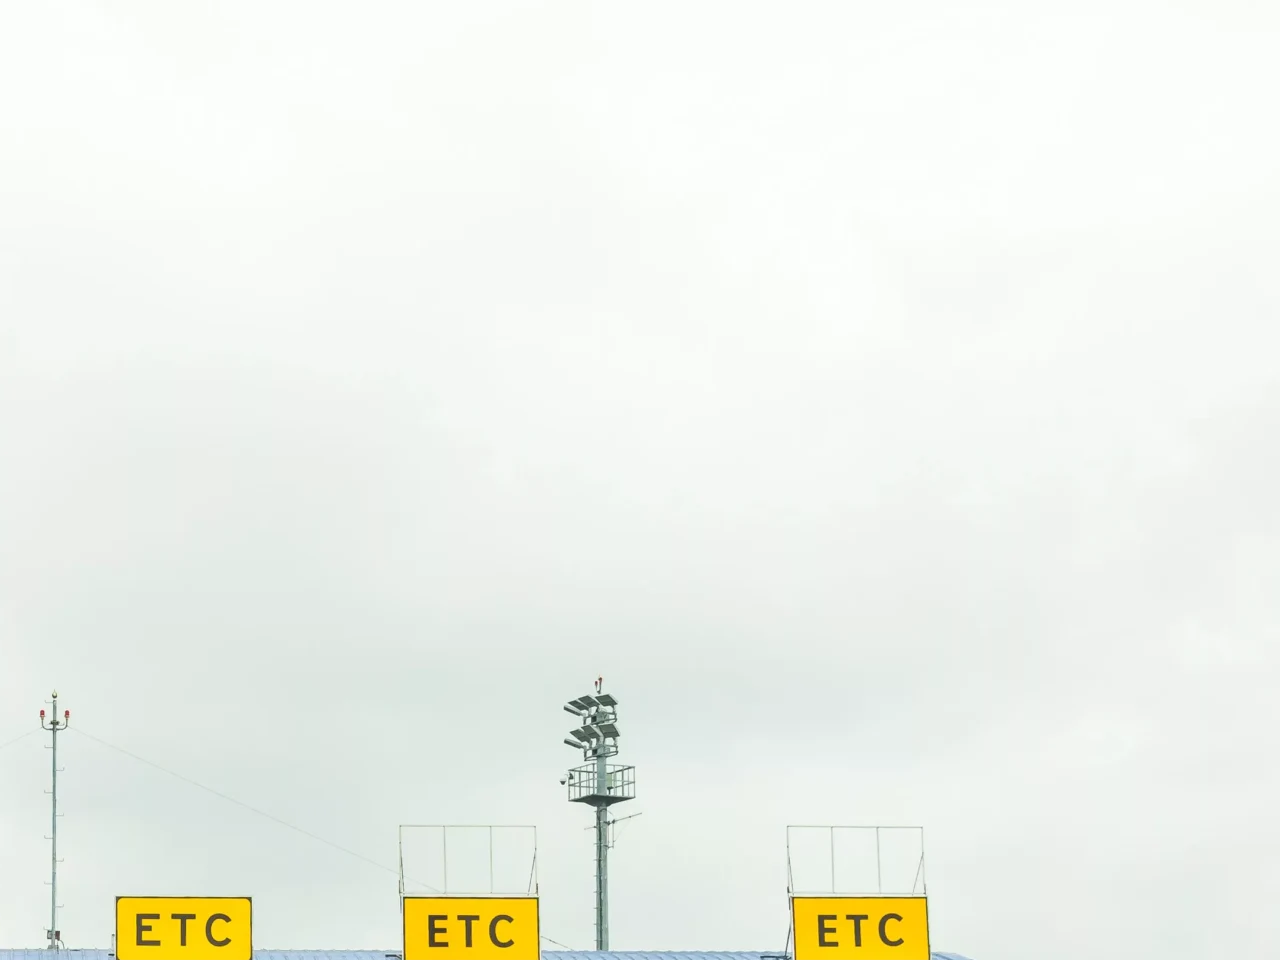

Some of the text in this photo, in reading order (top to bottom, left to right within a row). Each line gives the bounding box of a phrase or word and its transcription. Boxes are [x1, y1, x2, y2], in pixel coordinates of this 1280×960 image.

[135, 913, 232, 947] ETC
[427, 914, 516, 948] ETC
[817, 913, 905, 947] ETC
